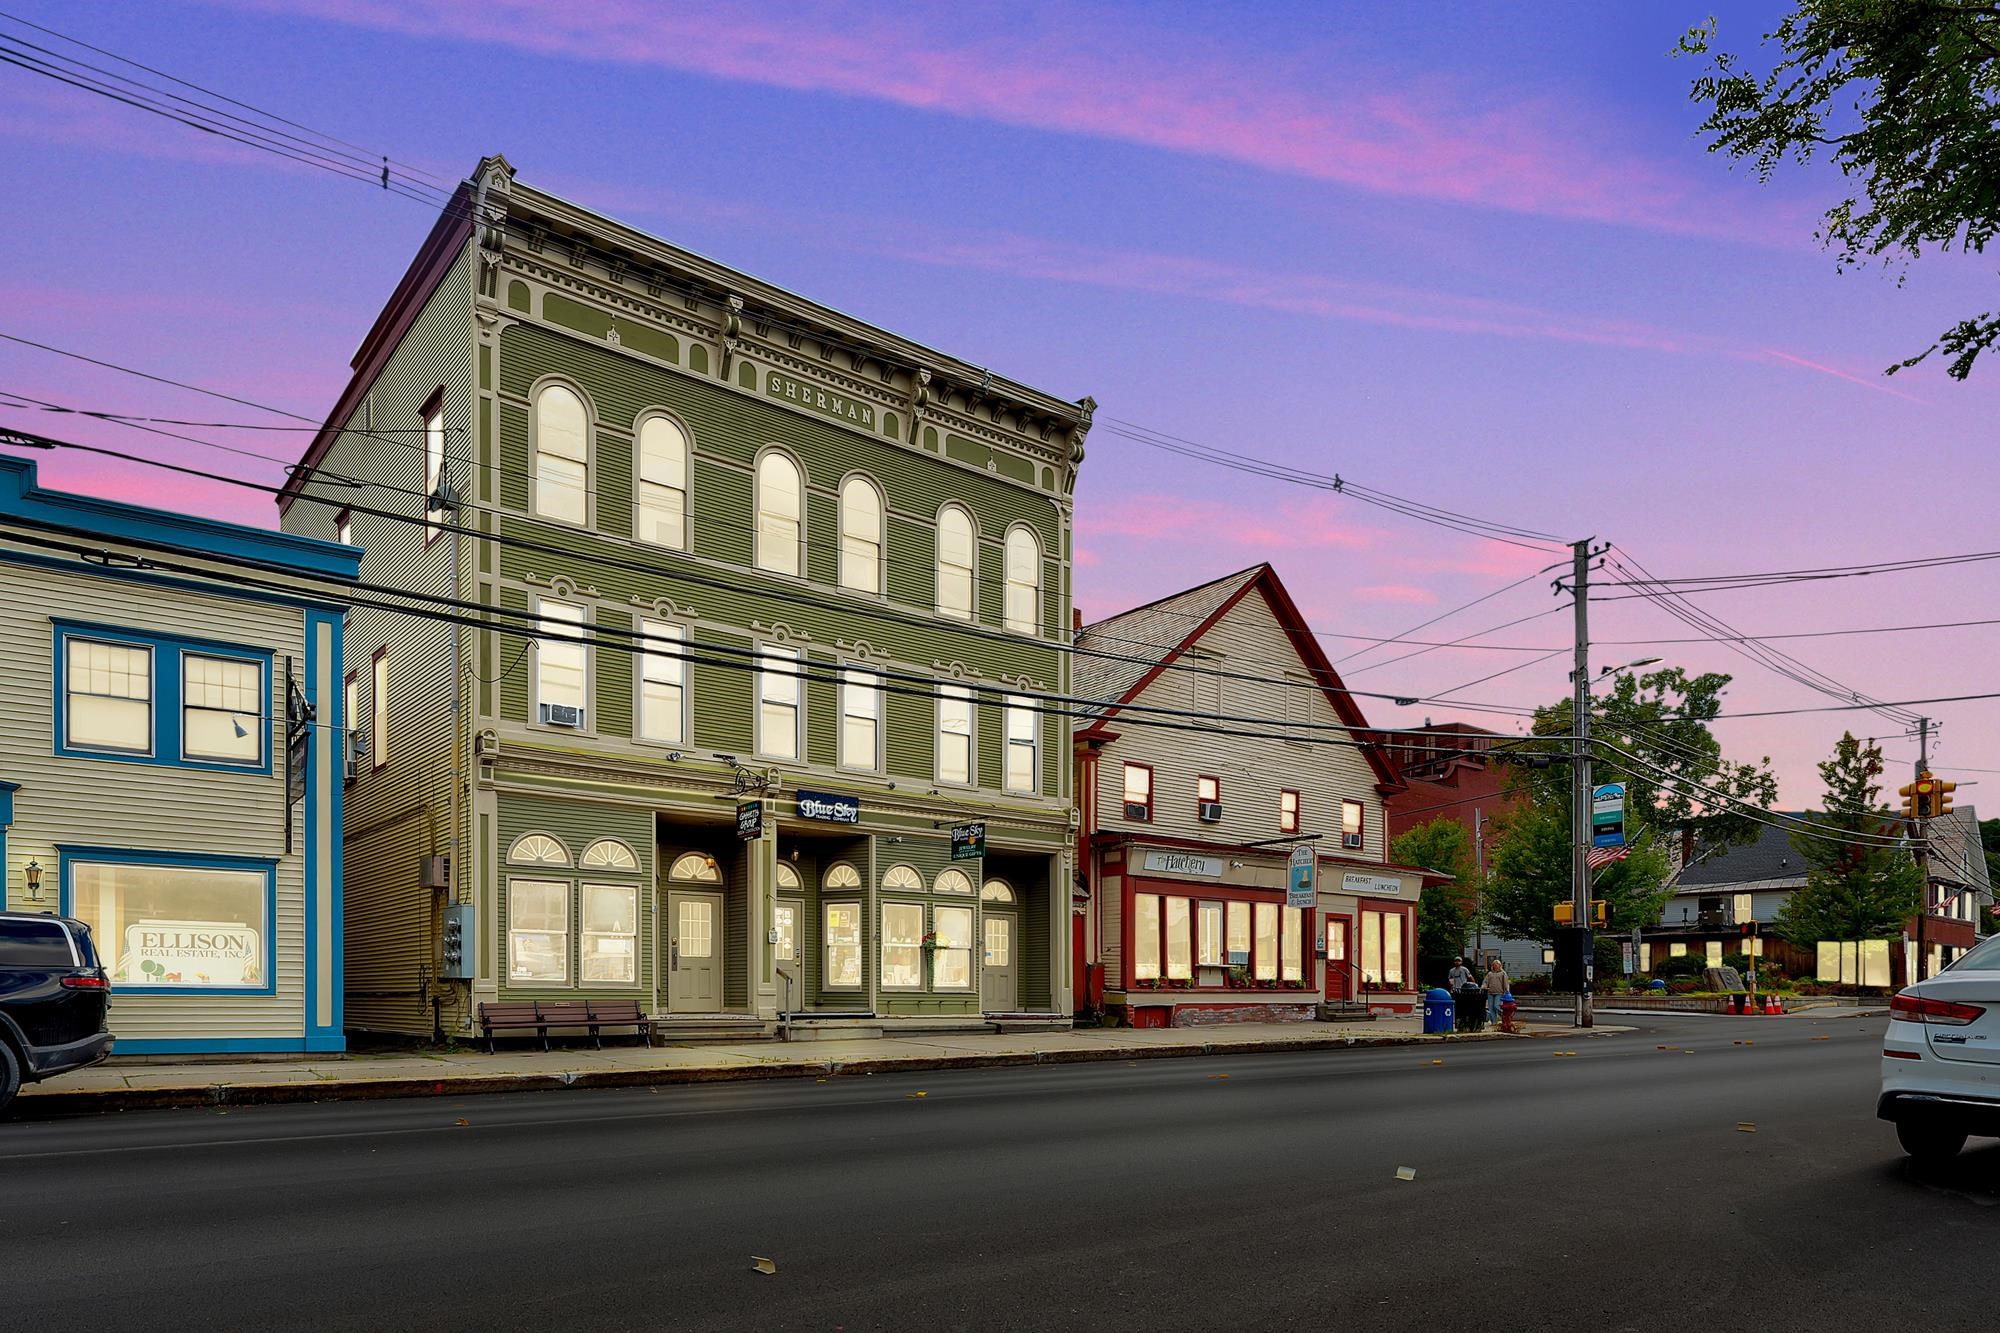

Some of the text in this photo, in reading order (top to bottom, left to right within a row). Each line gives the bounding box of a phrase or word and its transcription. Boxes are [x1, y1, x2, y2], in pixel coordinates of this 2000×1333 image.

[771, 377, 871, 424] SHERMAN
[800, 800, 857, 822] Blue Sky
[952, 825, 983, 841] Blue Sky
[1165, 855, 1205, 873] Hatchery
[1345, 875, 1372, 885] BREAKFAST
[1374, 883, 1398, 892] LUNCHEON
[141, 932, 244, 950] ELLISON
[140, 948, 173, 957] REAL
[177, 949, 220, 959] ESTATE,
